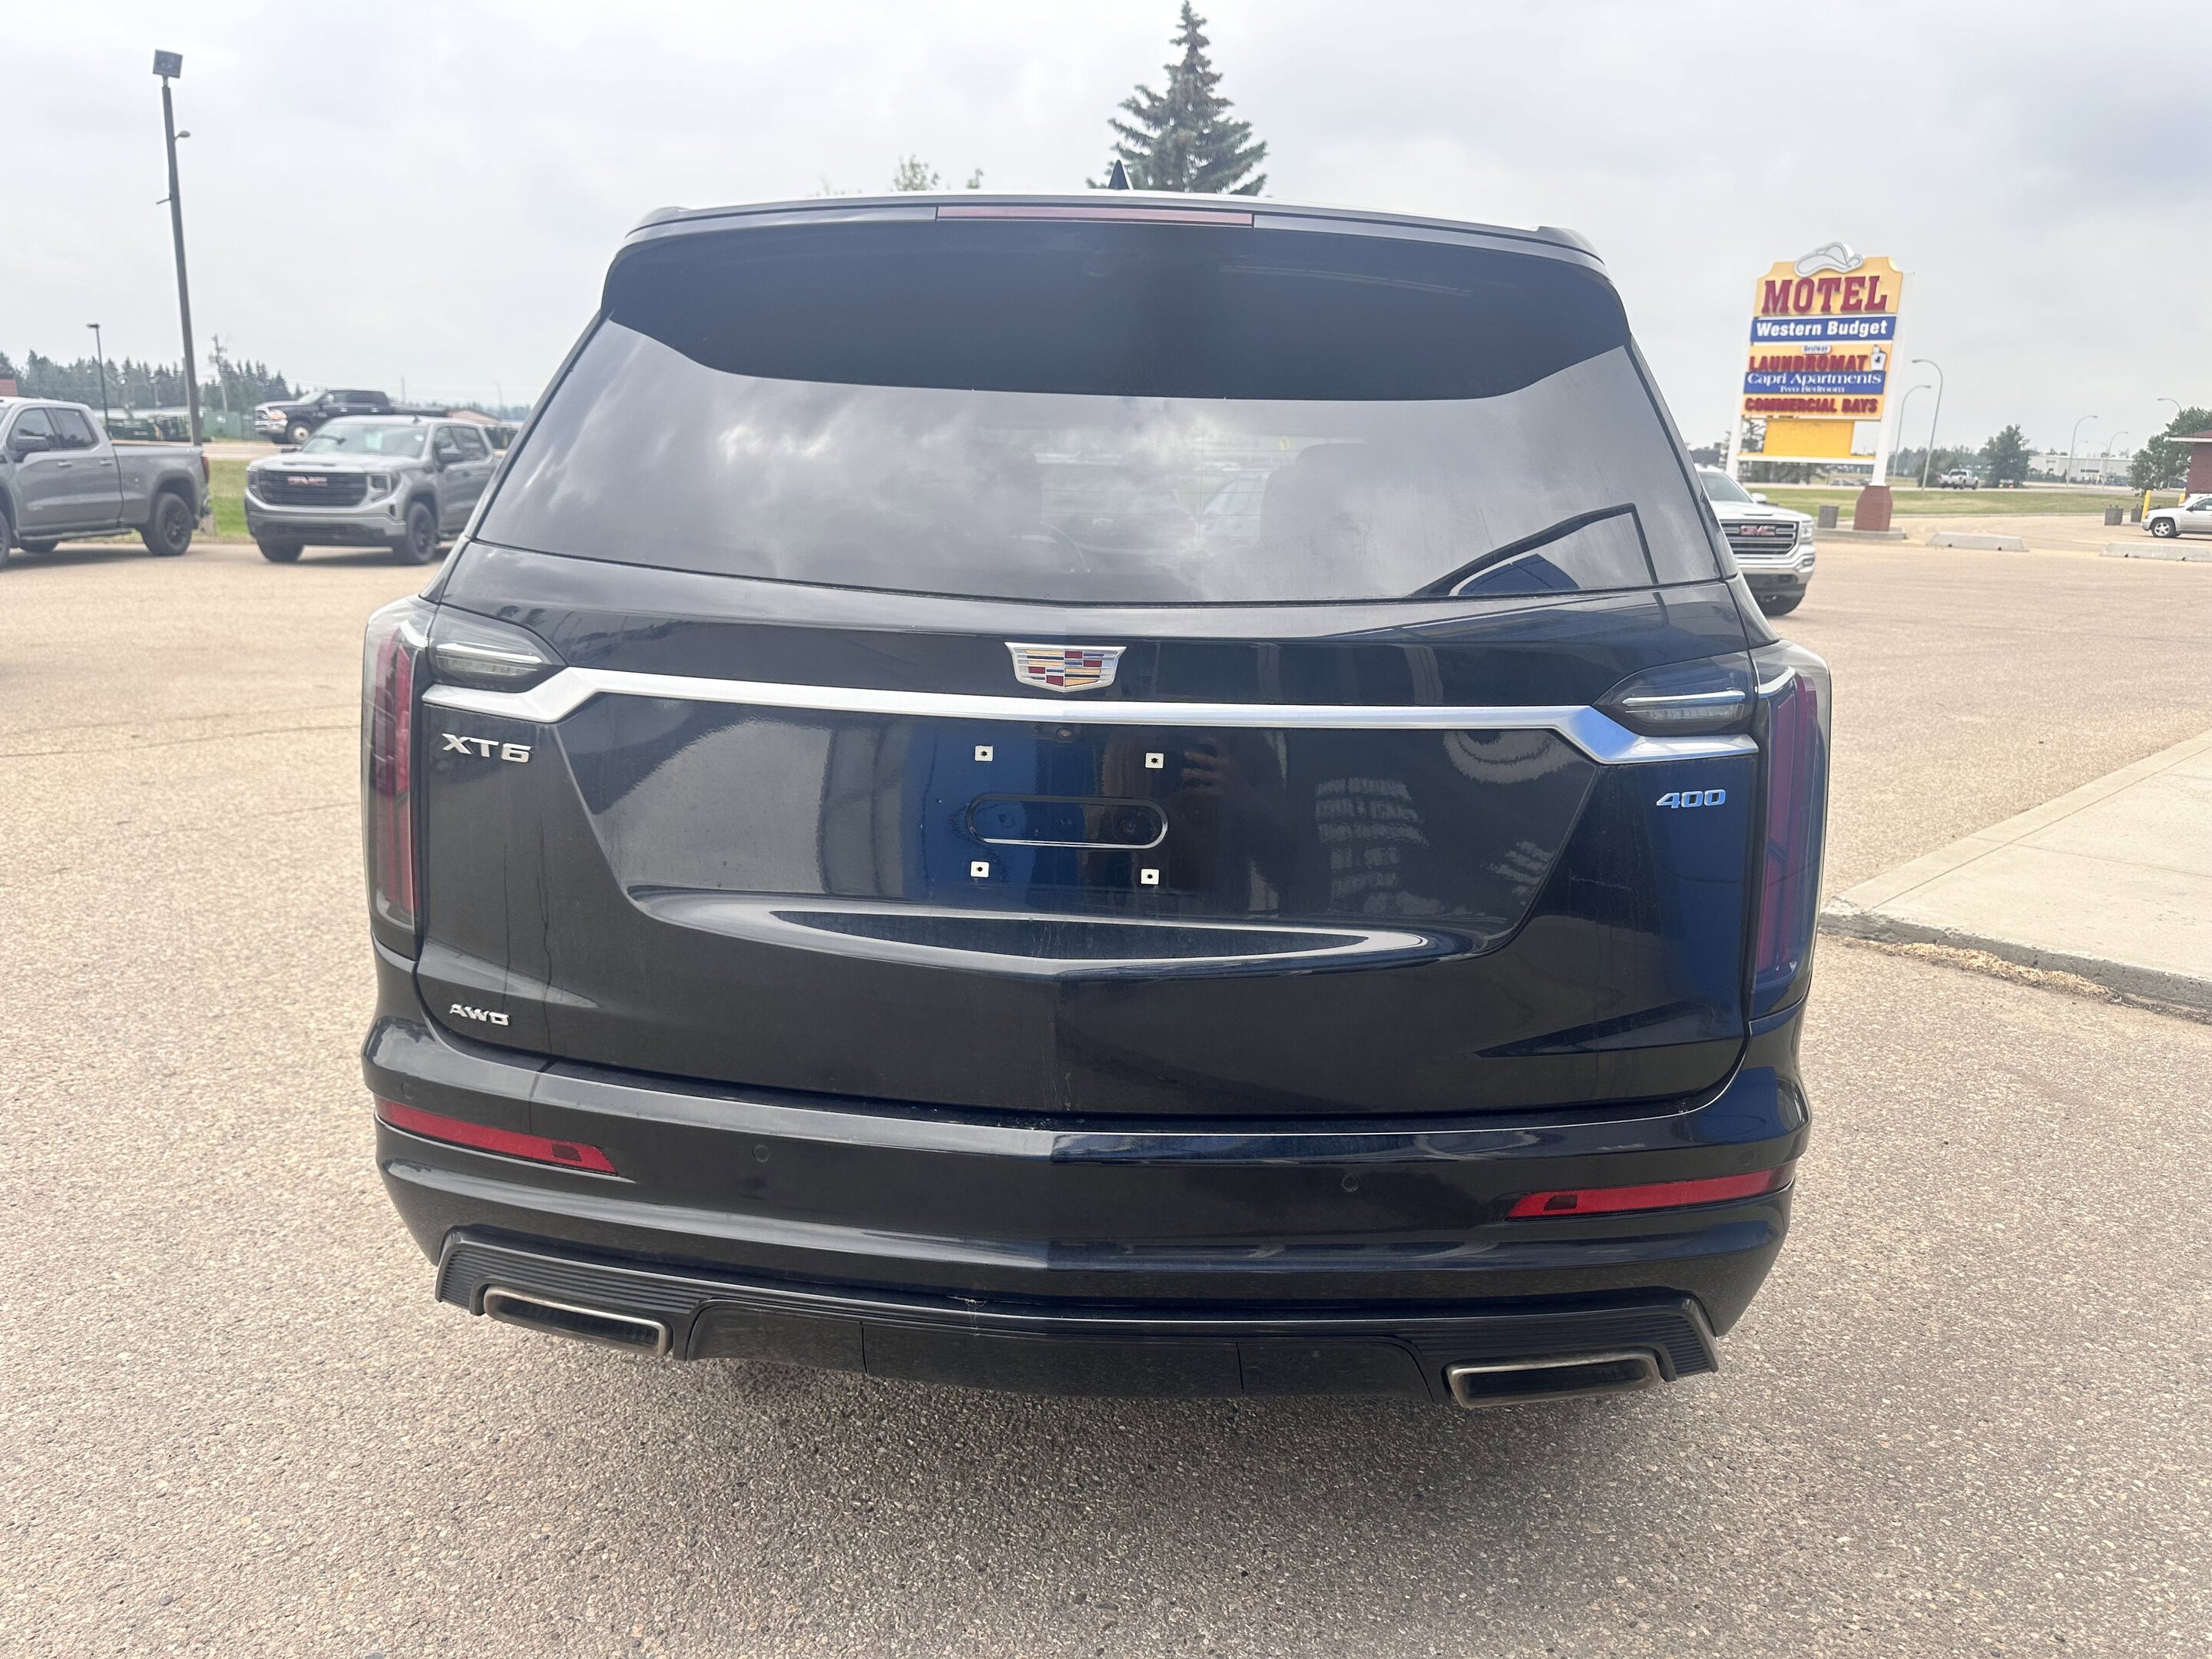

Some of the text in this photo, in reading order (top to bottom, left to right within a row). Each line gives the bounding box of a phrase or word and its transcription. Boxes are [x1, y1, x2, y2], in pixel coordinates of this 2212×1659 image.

[1760, 275, 1888, 314] MOTEL
[1756, 320, 1888, 338] Western Budget
[1748, 355, 1869, 372] LAUNDROMAT
[1747, 372, 1882, 386] Capri Apartments
[1744, 397, 1879, 413] COMMERCIAL BAYS
[1740, 525, 1776, 536] GMC
[442, 733, 532, 763] XT6
[1656, 789, 1727, 810] 400
[449, 1003, 510, 1026] AWD
